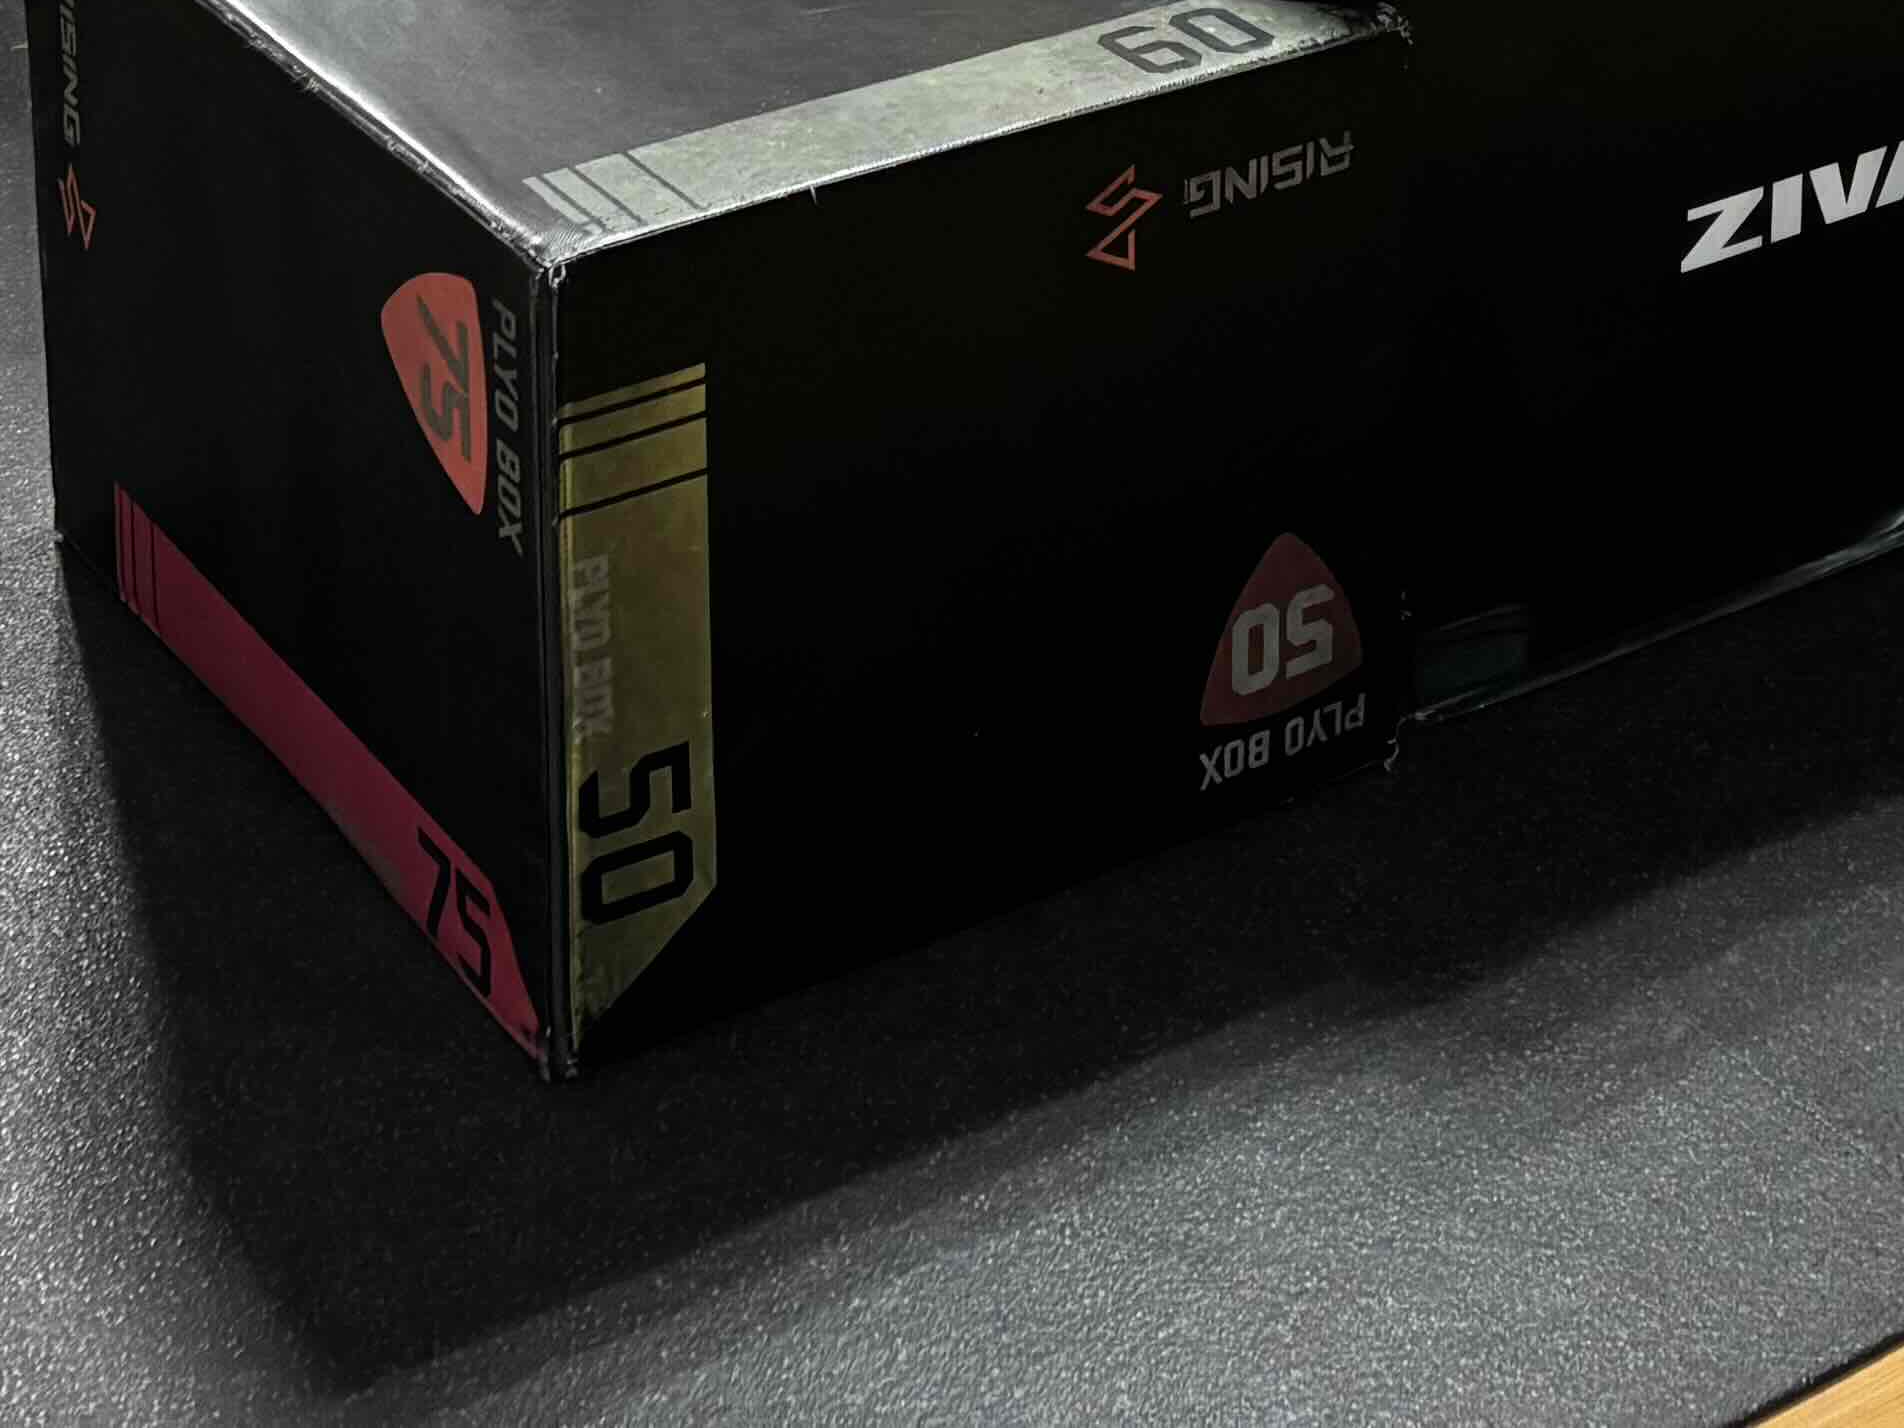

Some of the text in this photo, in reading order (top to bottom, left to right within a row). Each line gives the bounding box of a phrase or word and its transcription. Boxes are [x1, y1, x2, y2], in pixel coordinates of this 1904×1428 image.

[1097, 5, 1280, 75] 60
[1183, 130, 1356, 219] RISING
[416, 294, 472, 464] 75
[491, 298, 524, 558] PLYO BOX
[1231, 583, 1336, 696] 50
[1199, 693, 1367, 793] PLYO BOX
[577, 739, 696, 926] 50
[416, 826, 493, 1000] 75
